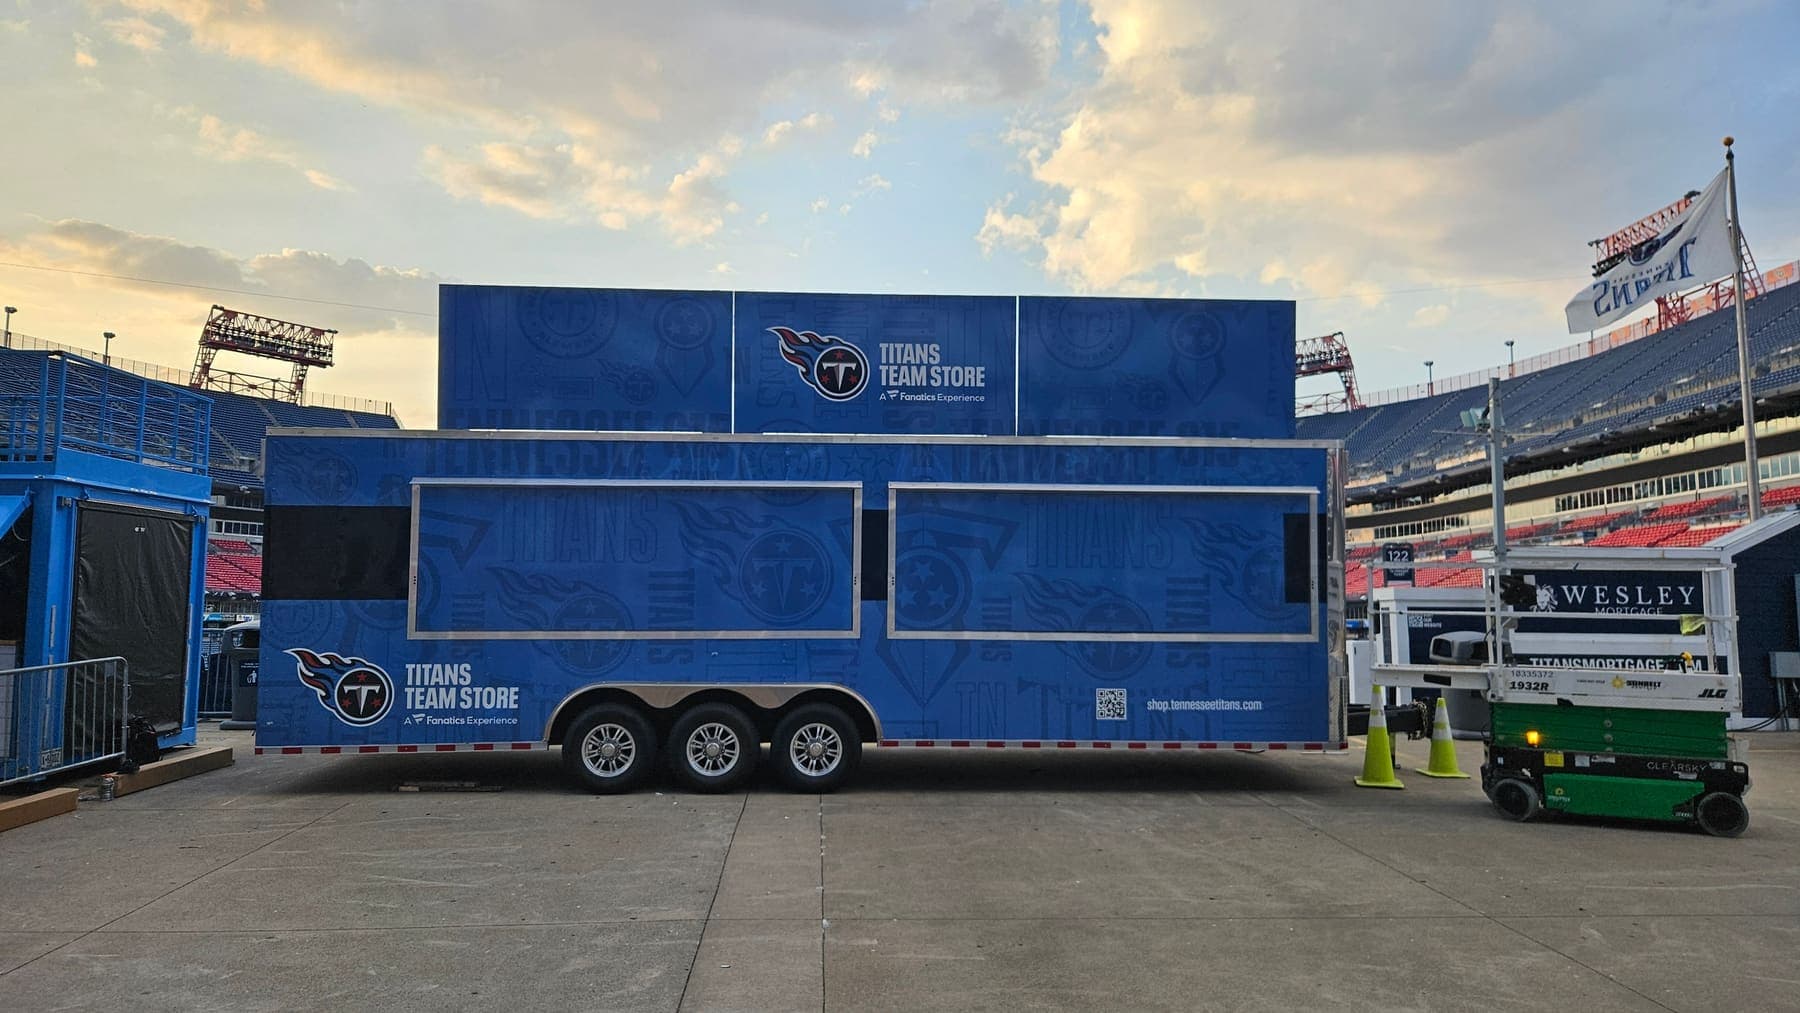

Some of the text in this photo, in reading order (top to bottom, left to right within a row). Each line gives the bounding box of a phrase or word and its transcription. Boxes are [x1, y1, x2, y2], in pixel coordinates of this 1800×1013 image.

[879, 343, 940, 365] TITANS
[879, 365, 985, 388] TEAM STORE
[879, 392, 985, 403] A Fanatics Experience
[1387, 550, 1409, 562] 122
[1560, 585, 1696, 605] WESLEY
[405, 663, 471, 686] TITANS
[1510, 681, 1549, 691] 1932R
[405, 687, 519, 710] TEAM STORE
[1698, 689, 1728, 699] JLG
[1147, 699, 1262, 712] shop.tennesseetitans.com
[404, 716, 518, 726] A Fanatics Experience
